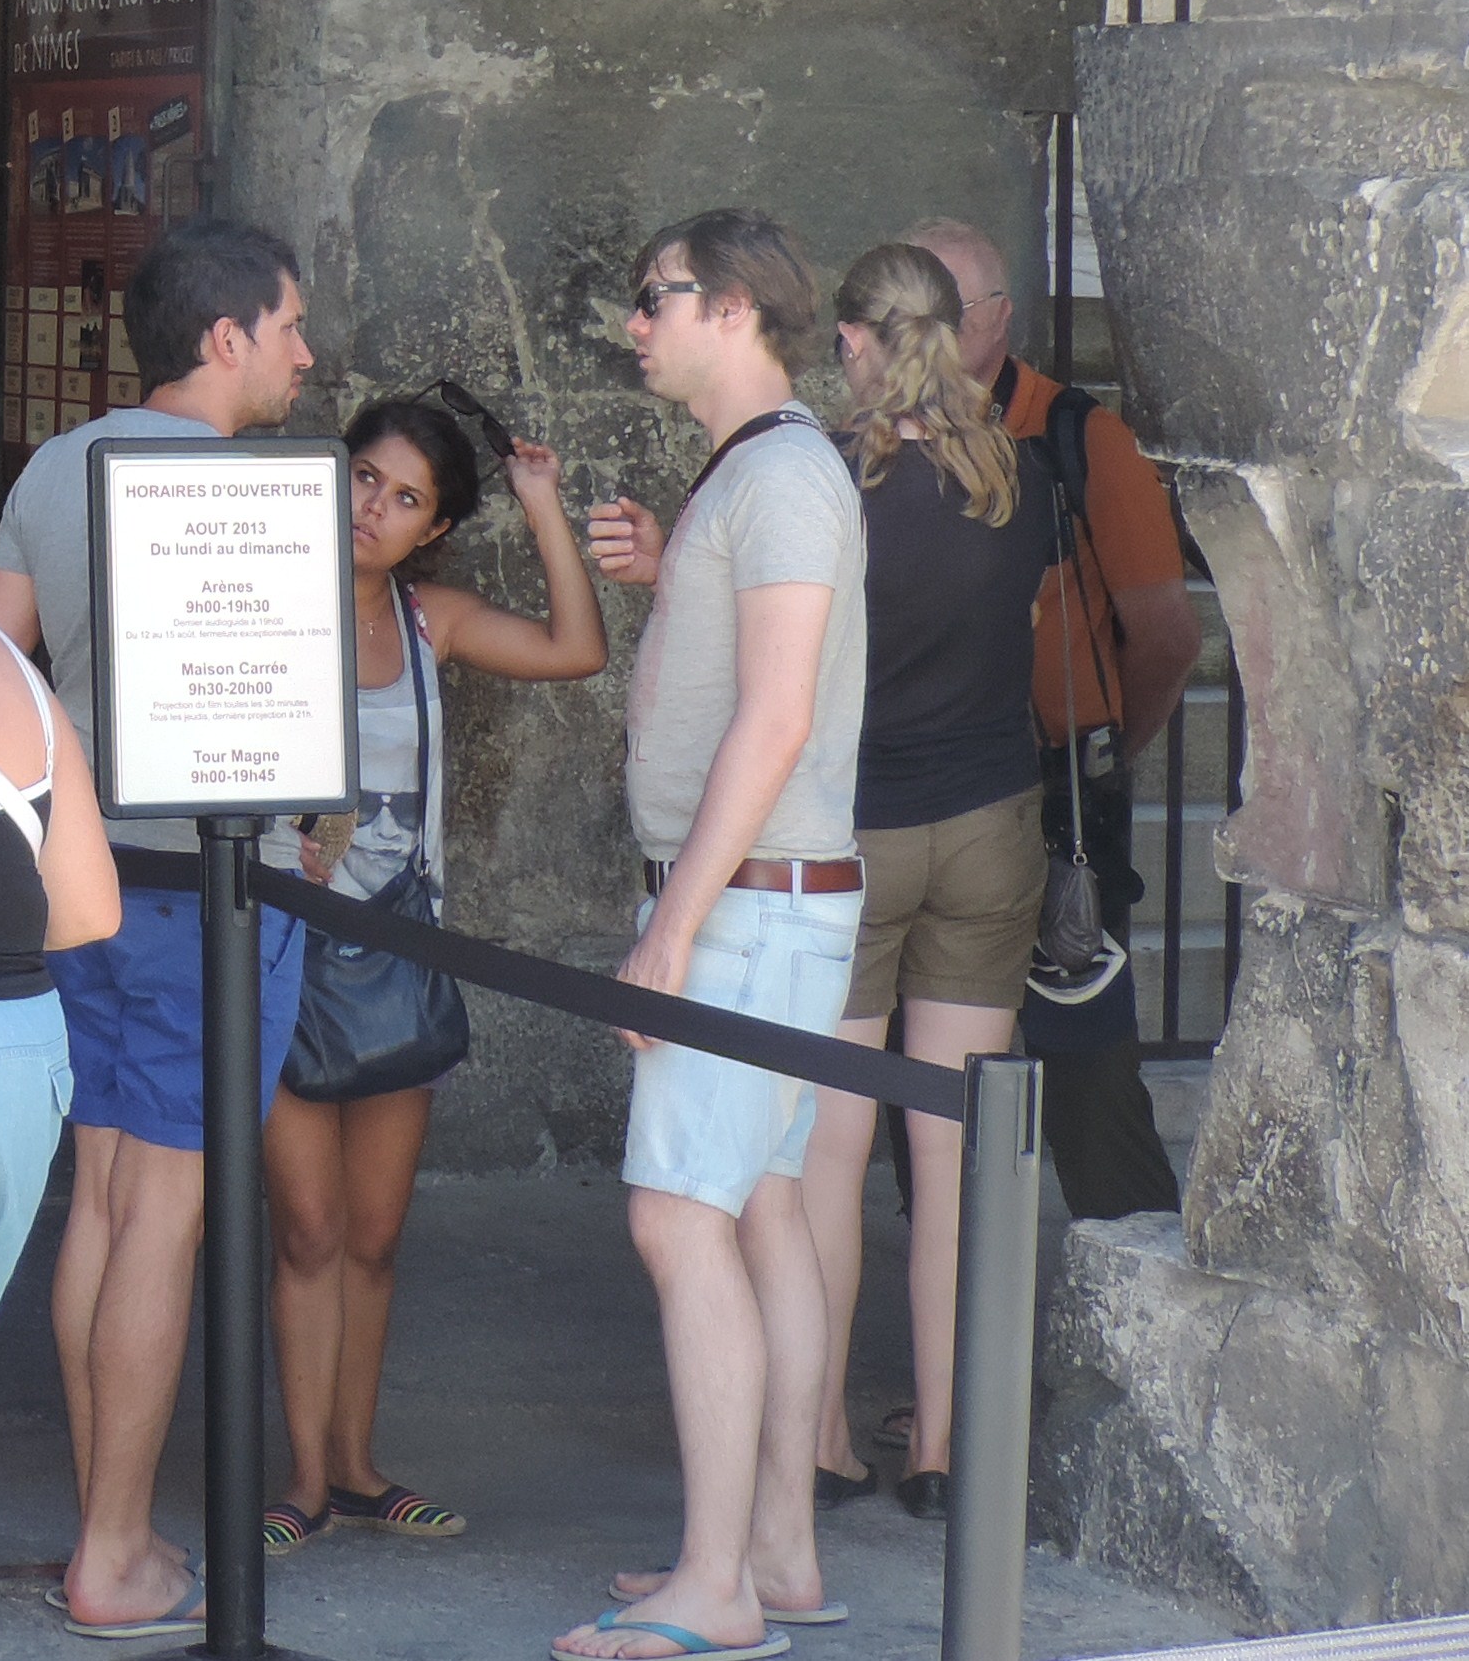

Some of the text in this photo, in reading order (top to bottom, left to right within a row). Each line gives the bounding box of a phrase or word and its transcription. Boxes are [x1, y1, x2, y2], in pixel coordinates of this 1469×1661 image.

[14, 25, 81, 73] DE NÎMES
[125, 483, 323, 499] HORAIRES D'OUVERTURE
[184, 521, 267, 536] AOUT 2013
[150, 541, 311, 556] Du lundi au dimanche
[201, 579, 254, 593] Arènes
[186, 599, 270, 614] 9h00-19h30
[125, 630, 138, 640] Du
[141, 630, 150, 639] 12
[181, 660, 288, 676] Maison Carrée
[188, 681, 273, 696] 9h30-20h00
[192, 749, 280, 766] Tour Magne
[190, 768, 276, 784] 9h00-19h45
